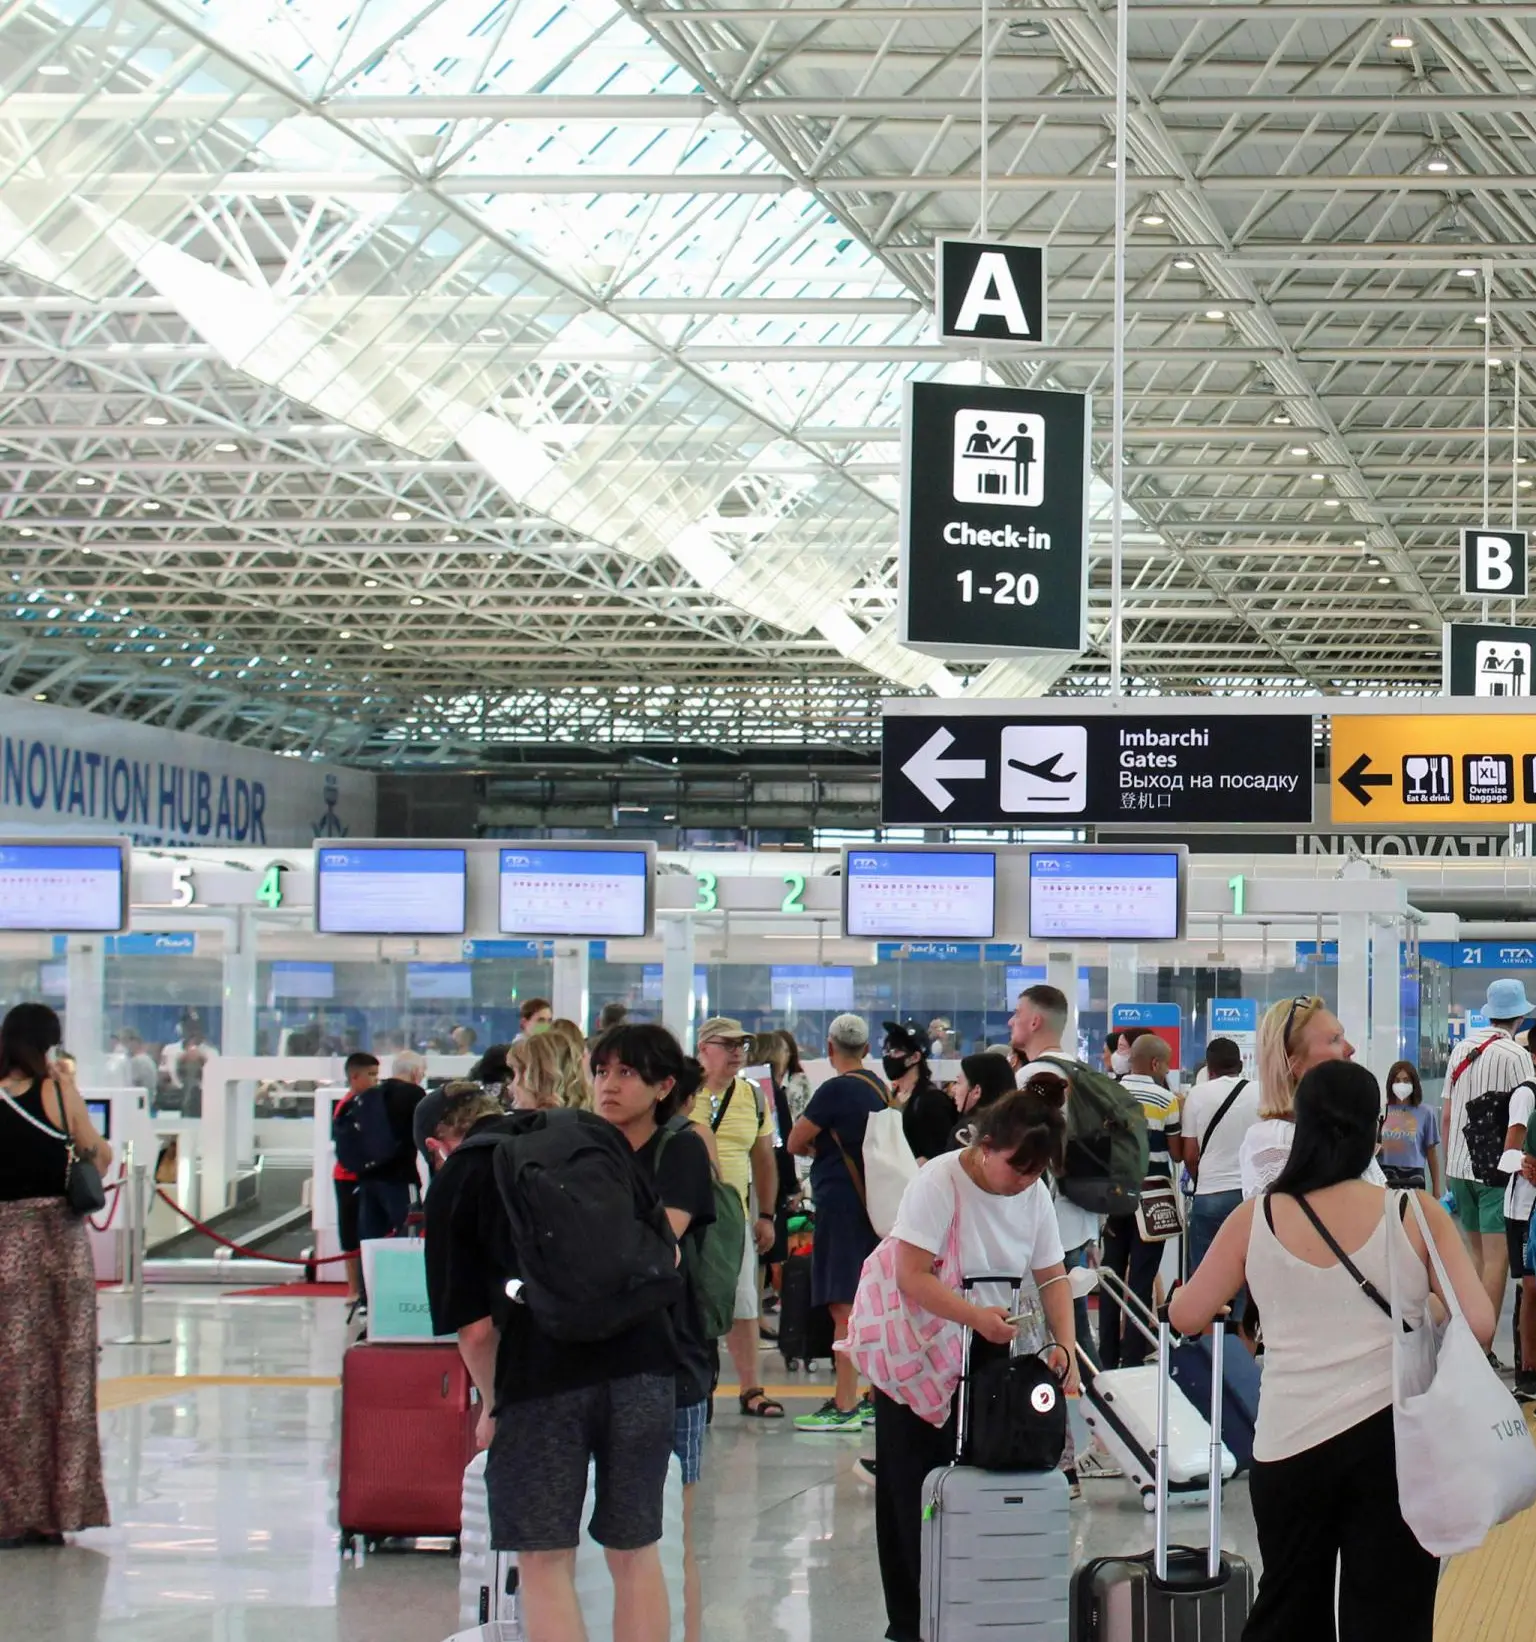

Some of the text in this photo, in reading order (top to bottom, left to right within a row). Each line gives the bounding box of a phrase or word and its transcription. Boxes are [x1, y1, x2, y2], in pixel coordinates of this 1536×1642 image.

[953, 252, 1031, 335] A
[943, 521, 1052, 551] Check-in
[1475, 536, 1515, 591] B
[956, 569, 1041, 606] 1-20
[1119, 728, 1209, 747] Imbarchi
[1119, 750, 1178, 768] Gates
[1119, 771, 1299, 792] Выход на посадку
[1479, 767, 1498, 779] XL
[0, 735, 267, 845] NOVATION HUB ADR
[1119, 791, 1172, 810] 登机口
[1406, 794, 1420, 802] Eat
[1429, 794, 1451, 802] drink
[1469, 786, 1508, 795] Oversize
[1469, 793, 1508, 804] baggage
[171, 864, 196, 908] 5
[256, 865, 284, 910] 4
[696, 871, 718, 913] 3
[780, 871, 806, 913] 2
[1227, 873, 1247, 916] 1
[1462, 947, 1482, 964] 21
[1499, 948, 1535, 958] ITA
